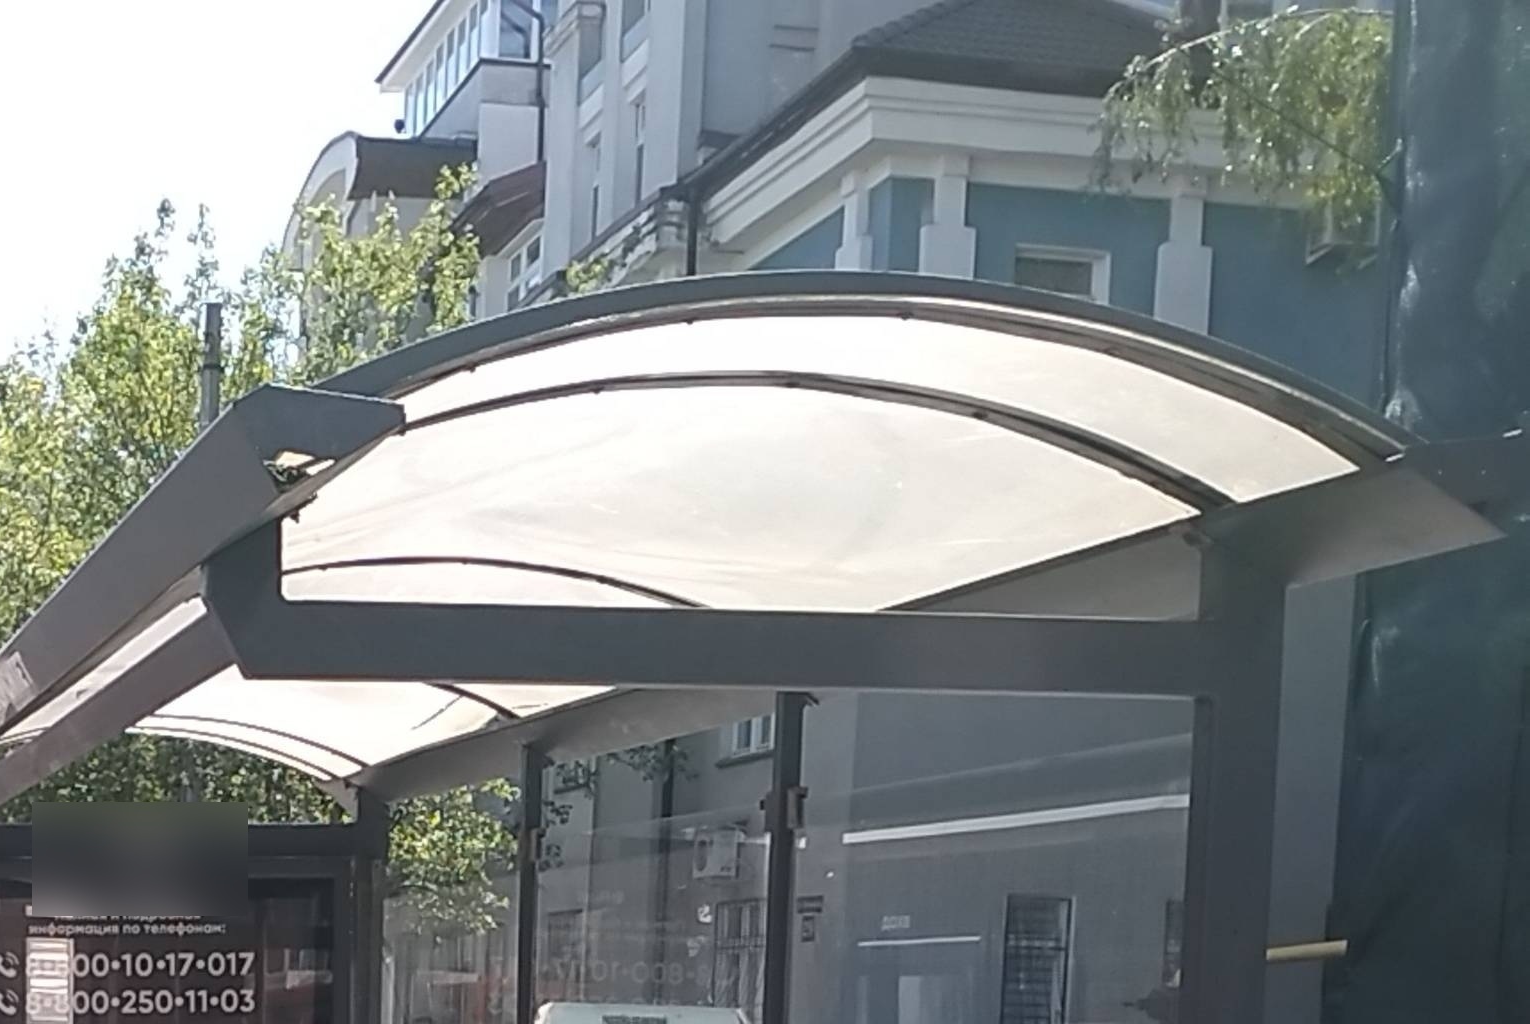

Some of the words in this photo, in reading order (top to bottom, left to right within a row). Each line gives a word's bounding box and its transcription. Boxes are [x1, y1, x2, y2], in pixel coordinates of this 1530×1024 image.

[29, 922, 120, 937] информация
[123, 923, 141, 935] по
[144, 921, 227, 937] телефонам:
